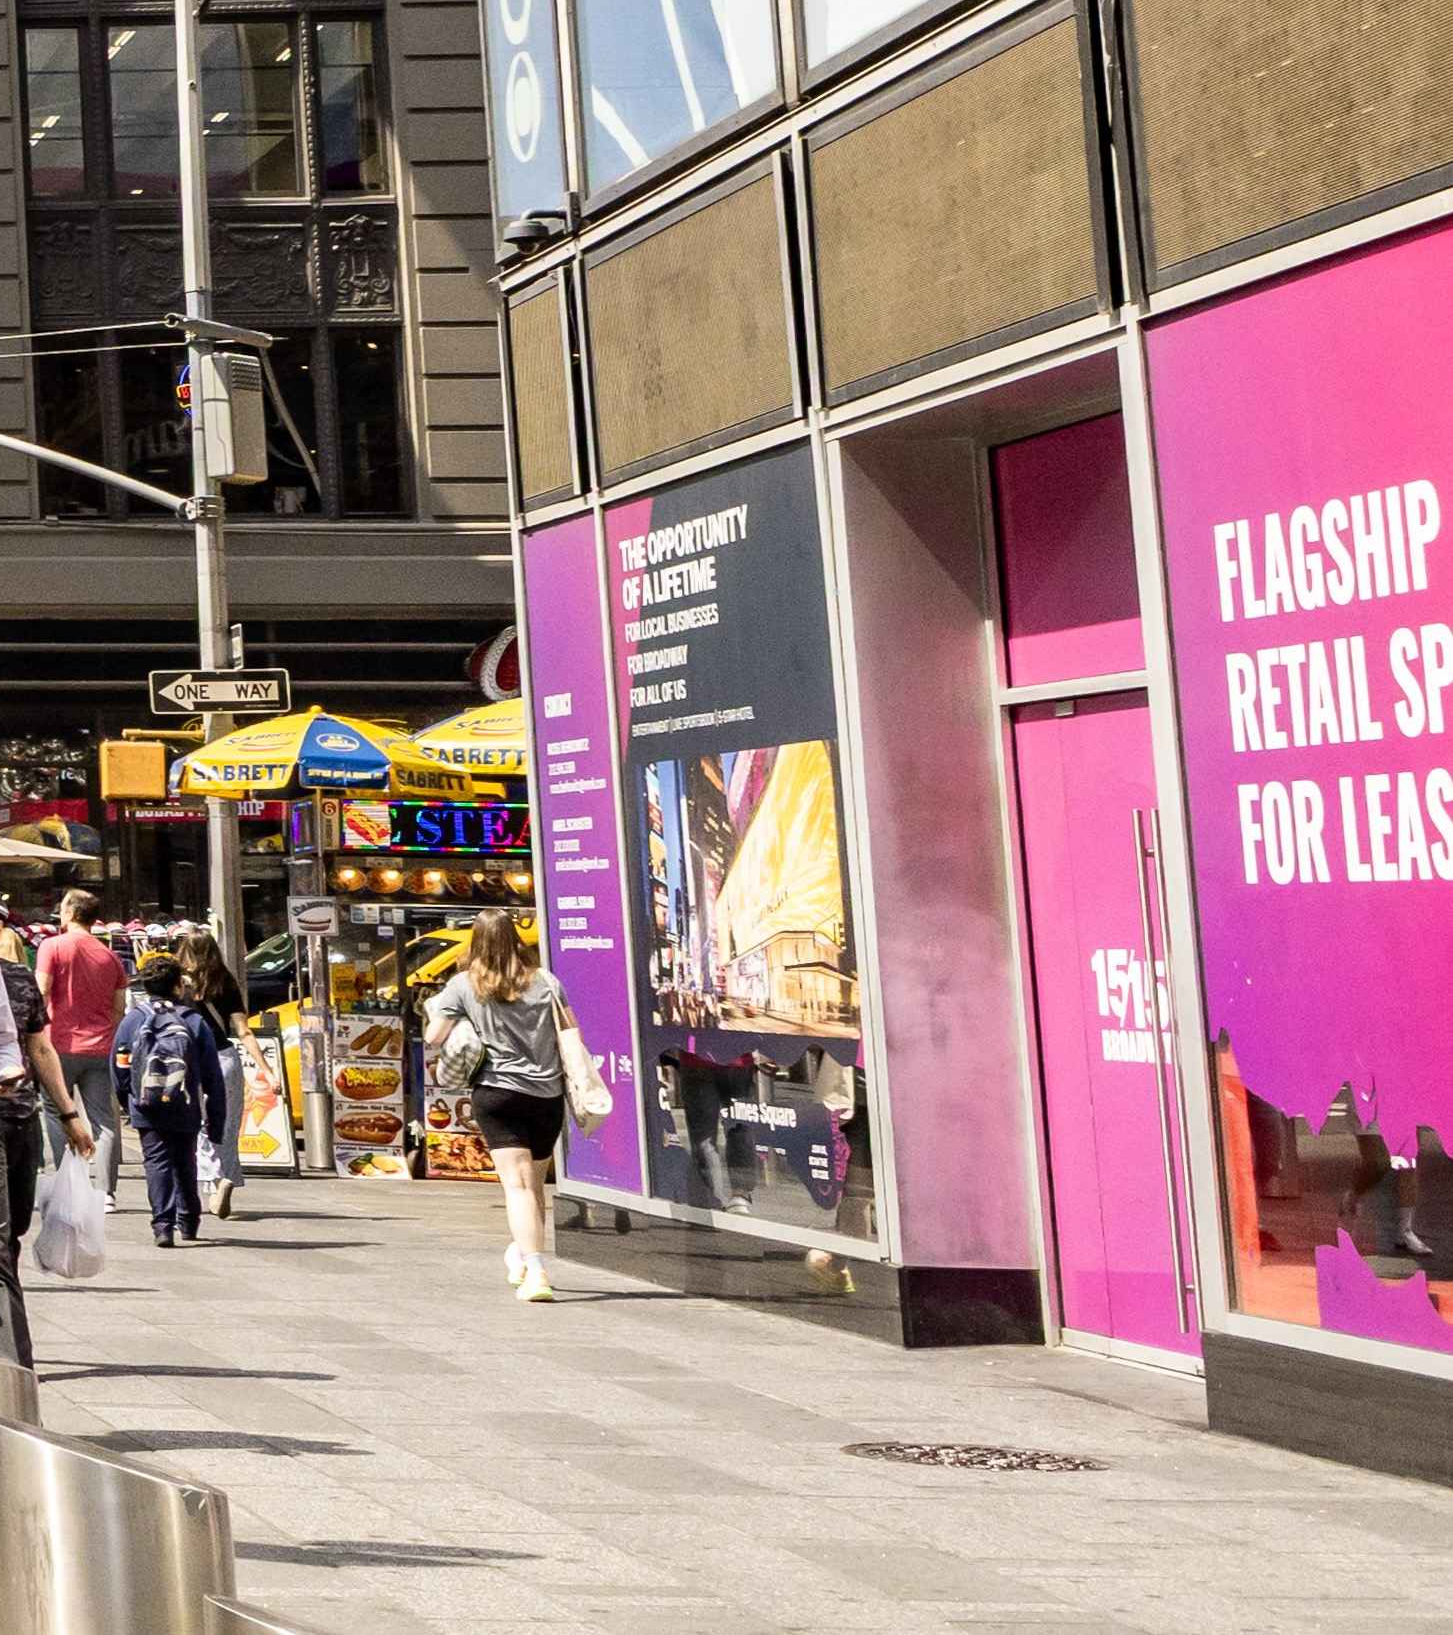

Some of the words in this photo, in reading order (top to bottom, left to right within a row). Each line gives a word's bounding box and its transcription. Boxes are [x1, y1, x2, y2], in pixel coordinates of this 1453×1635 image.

[619, 535, 648, 572] THE
[647, 503, 748, 566] OPPORTUNITY
[1213, 479, 1444, 624] FLAGSHIP
[622, 577, 641, 611] OF
[642, 573, 655, 606] A
[654, 555, 718, 604] LIFETIME
[624, 621, 642, 643] FOR
[641, 615, 668, 640] LOCAL
[667, 602, 719, 635] BUSINESSES
[626, 654, 644, 676] FOR
[643, 644, 689, 673] BROADWAY
[173, 684, 211, 701] ONE
[234, 682, 273, 700] WAY
[629, 686, 648, 708] FOR
[646, 683, 662, 705] ALL
[661, 681, 675, 703] OF
[673, 678, 688, 701] US
[1225, 645, 1384, 754] RETAIL
[191, 763, 290, 783] SABRETT
[395, 769, 466, 792] SABRETT
[1237, 782, 1326, 886] FOR
[1344, 770, 1453, 886] LEAS
[759, 1103, 798, 1131] Square
